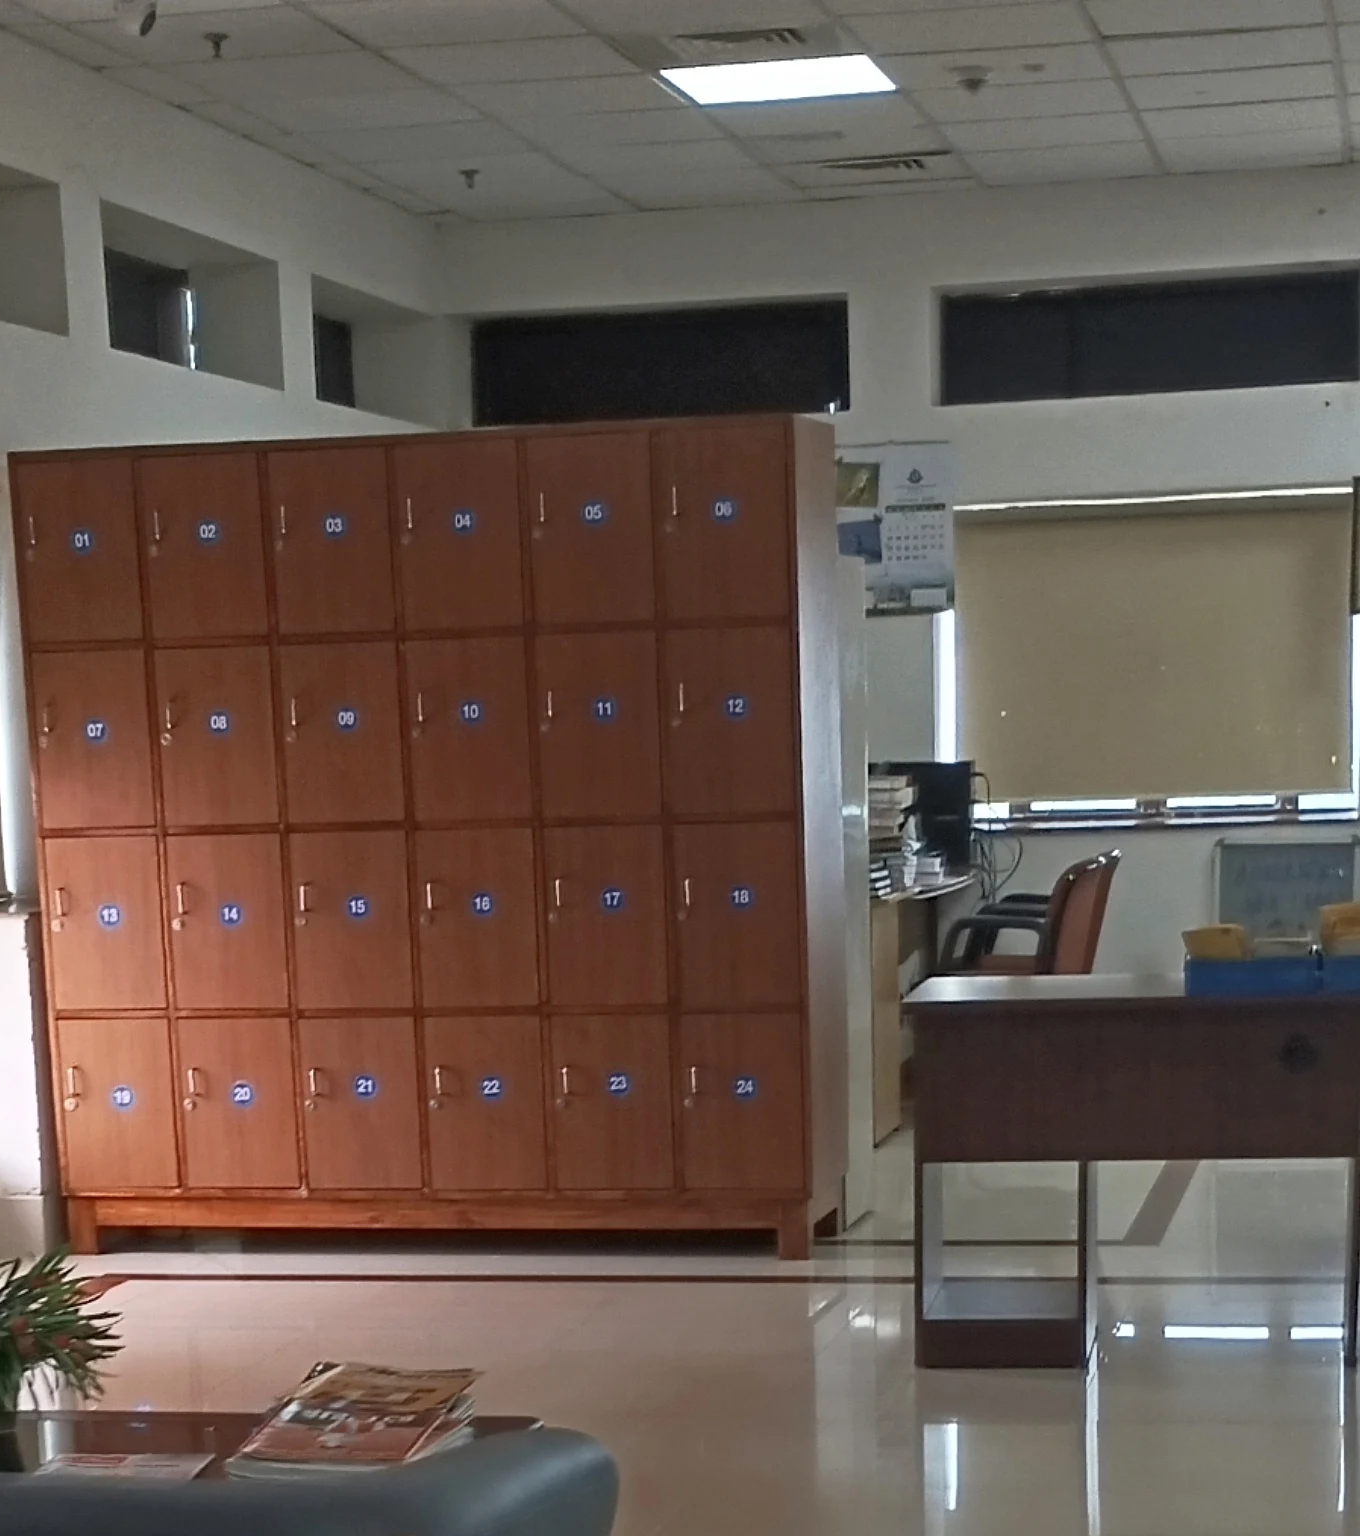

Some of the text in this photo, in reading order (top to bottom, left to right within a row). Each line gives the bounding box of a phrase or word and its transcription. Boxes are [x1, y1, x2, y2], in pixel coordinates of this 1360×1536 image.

[584, 504, 602, 520] 05
[714, 501, 733, 517] 06
[325, 517, 343, 533] 03
[454, 514, 471, 528] 04
[199, 524, 216, 539] 02
[74, 533, 90, 548] 01
[462, 704, 479, 719] 10
[597, 701, 612, 716] 11
[727, 698, 744, 713] 12
[210, 715, 228, 730] 08
[338, 711, 355, 726] 09
[86, 723, 104, 737] 07
[474, 896, 490, 911] 16
[604, 891, 621, 906] 17
[732, 889, 749, 904] 18
[223, 906, 238, 921] 14
[349, 899, 366, 914] 15
[101, 908, 118, 923] 13
[357, 1079, 373, 1093] 21
[482, 1079, 501, 1095] 22
[609, 1075, 627, 1091] 23
[736, 1079, 754, 1094] 24
[113, 1090, 131, 1104] 19
[233, 1087, 251, 1102] 20
